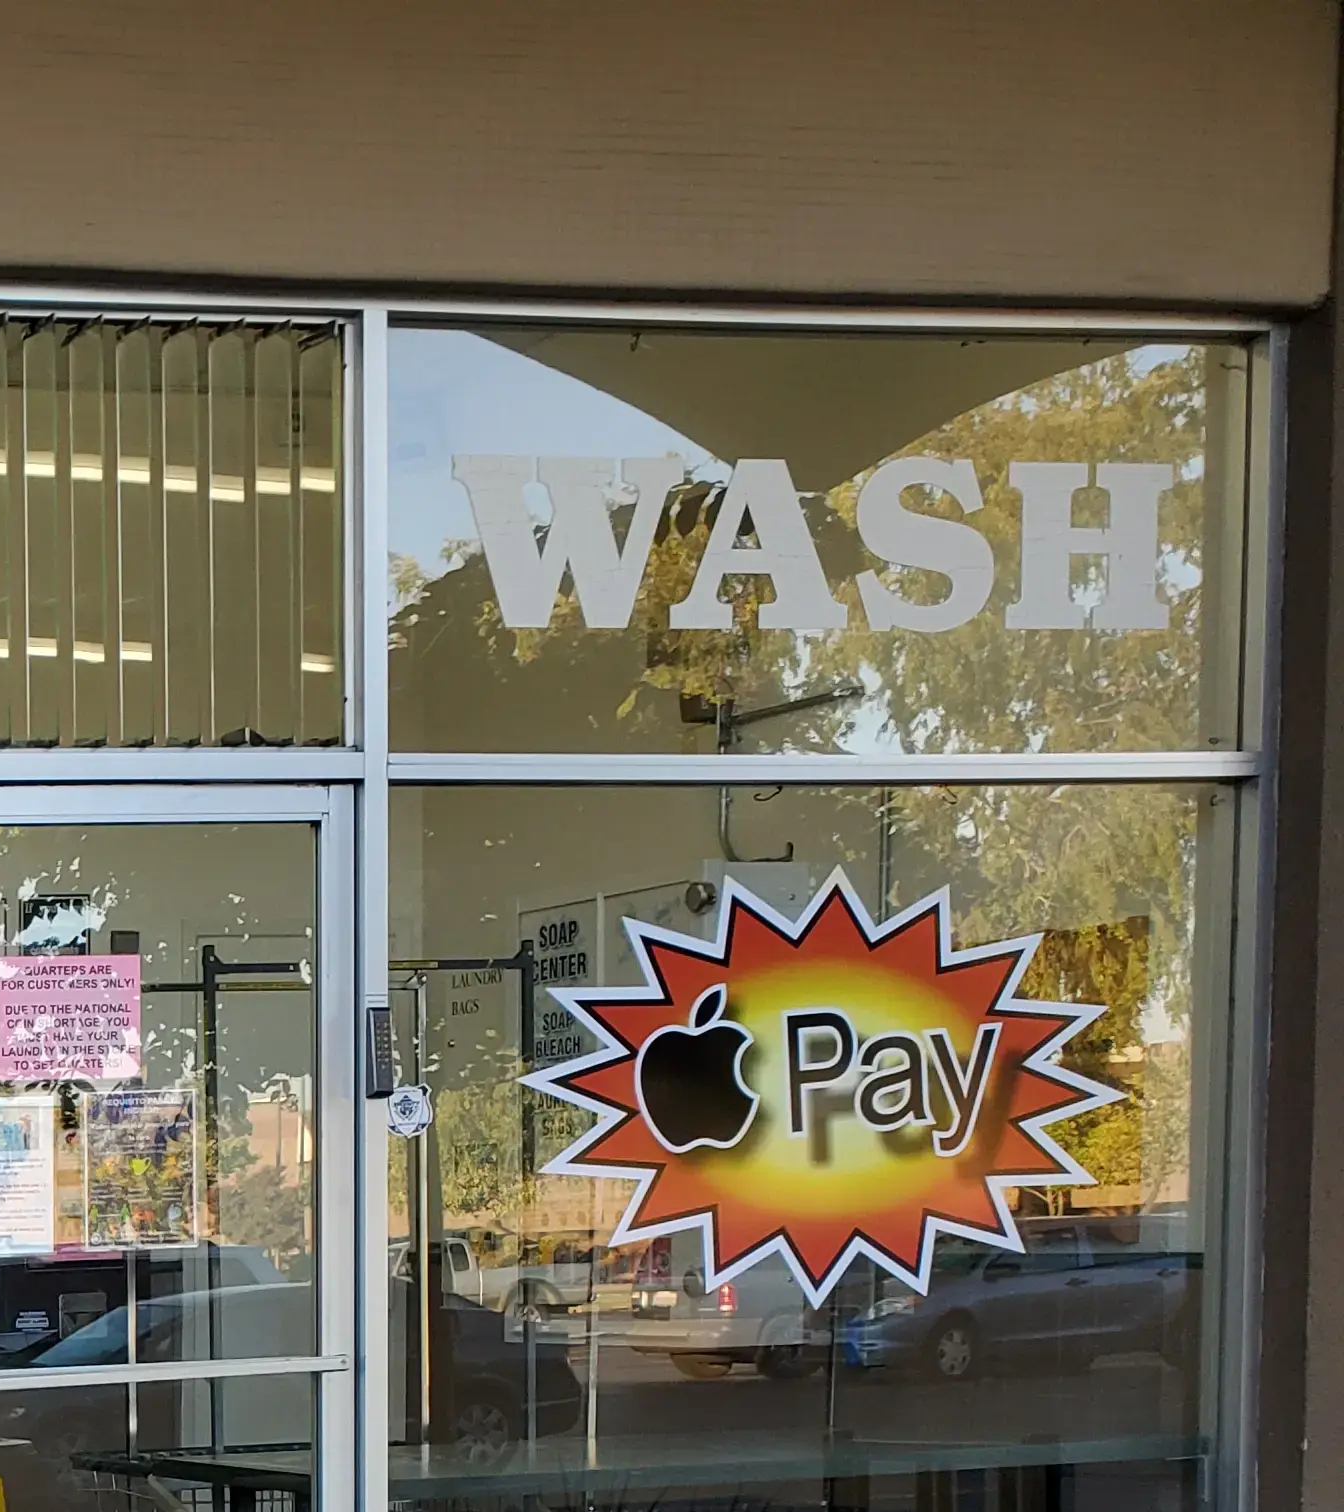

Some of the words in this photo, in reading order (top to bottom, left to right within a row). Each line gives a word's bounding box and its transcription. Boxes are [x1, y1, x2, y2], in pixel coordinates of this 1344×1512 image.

[451, 453, 1175, 634] WASH
[539, 920, 579, 948] SOAP
[25, 965, 86, 976] QUARTERS
[89, 965, 112, 975] ARE
[532, 952, 587, 984] CENTER
[1, 980, 24, 990] FOR
[28, 979, 97, 990] CUSTOMERS
[102, 978, 134, 988] ONLY!
[451, 968, 505, 989] LAUNDRY
[5, 1004, 28, 1015] DUE
[31, 1004, 47, 1014] TO
[50, 1004, 72, 1014] THE
[75, 1003, 131, 1013] NATIONAL
[451, 999, 479, 1016] BAGS
[107, 1017, 130, 1027] YOU
[543, 1012, 575, 1031] SOAP
[15, 1032, 49, 1042] UST
[53, 1031, 83, 1042] HAVE
[87, 1031, 119, 1041] YOUR
[73, 1045, 94, 1055] THE
[535, 1038, 581, 1059] BLEACH
[14, 1060, 29, 1070] TO
[33, 1060, 54, 1070] GET
[783, 1008, 1002, 1157] Pay
